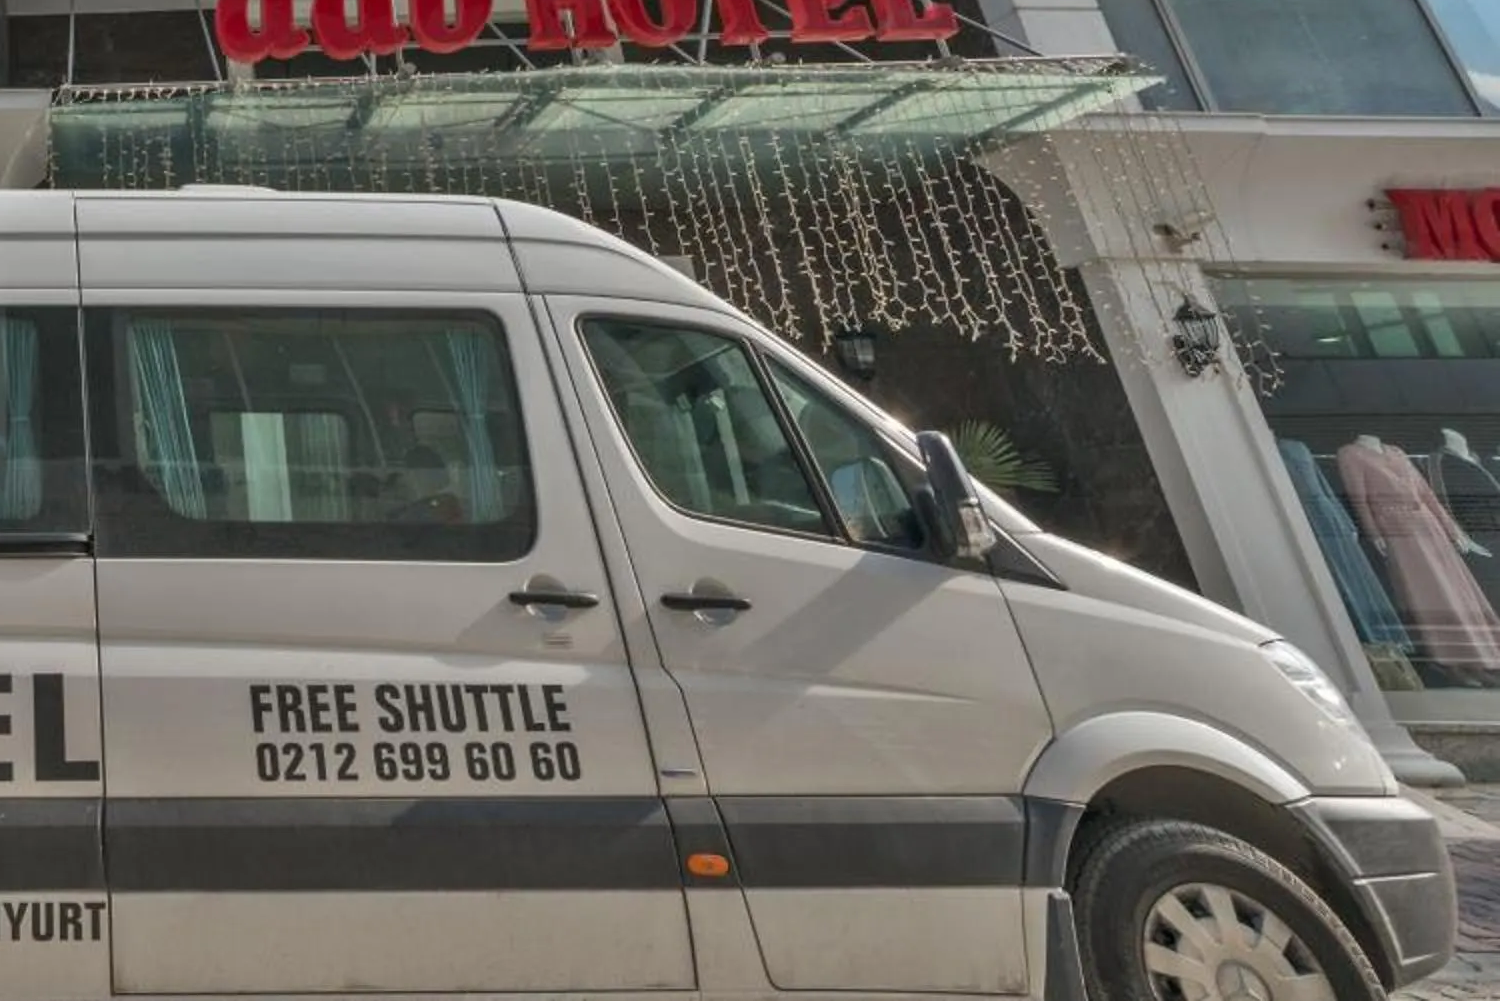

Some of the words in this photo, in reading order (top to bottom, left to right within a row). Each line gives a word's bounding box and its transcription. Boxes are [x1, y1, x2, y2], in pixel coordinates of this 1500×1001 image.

[249, 684, 360, 733] FREE
[374, 684, 571, 733] SHUTTLE
[255, 742, 359, 782] 0212
[373, 742, 451, 782] 699
[464, 742, 517, 782] 60
[529, 742, 581, 782] 60
